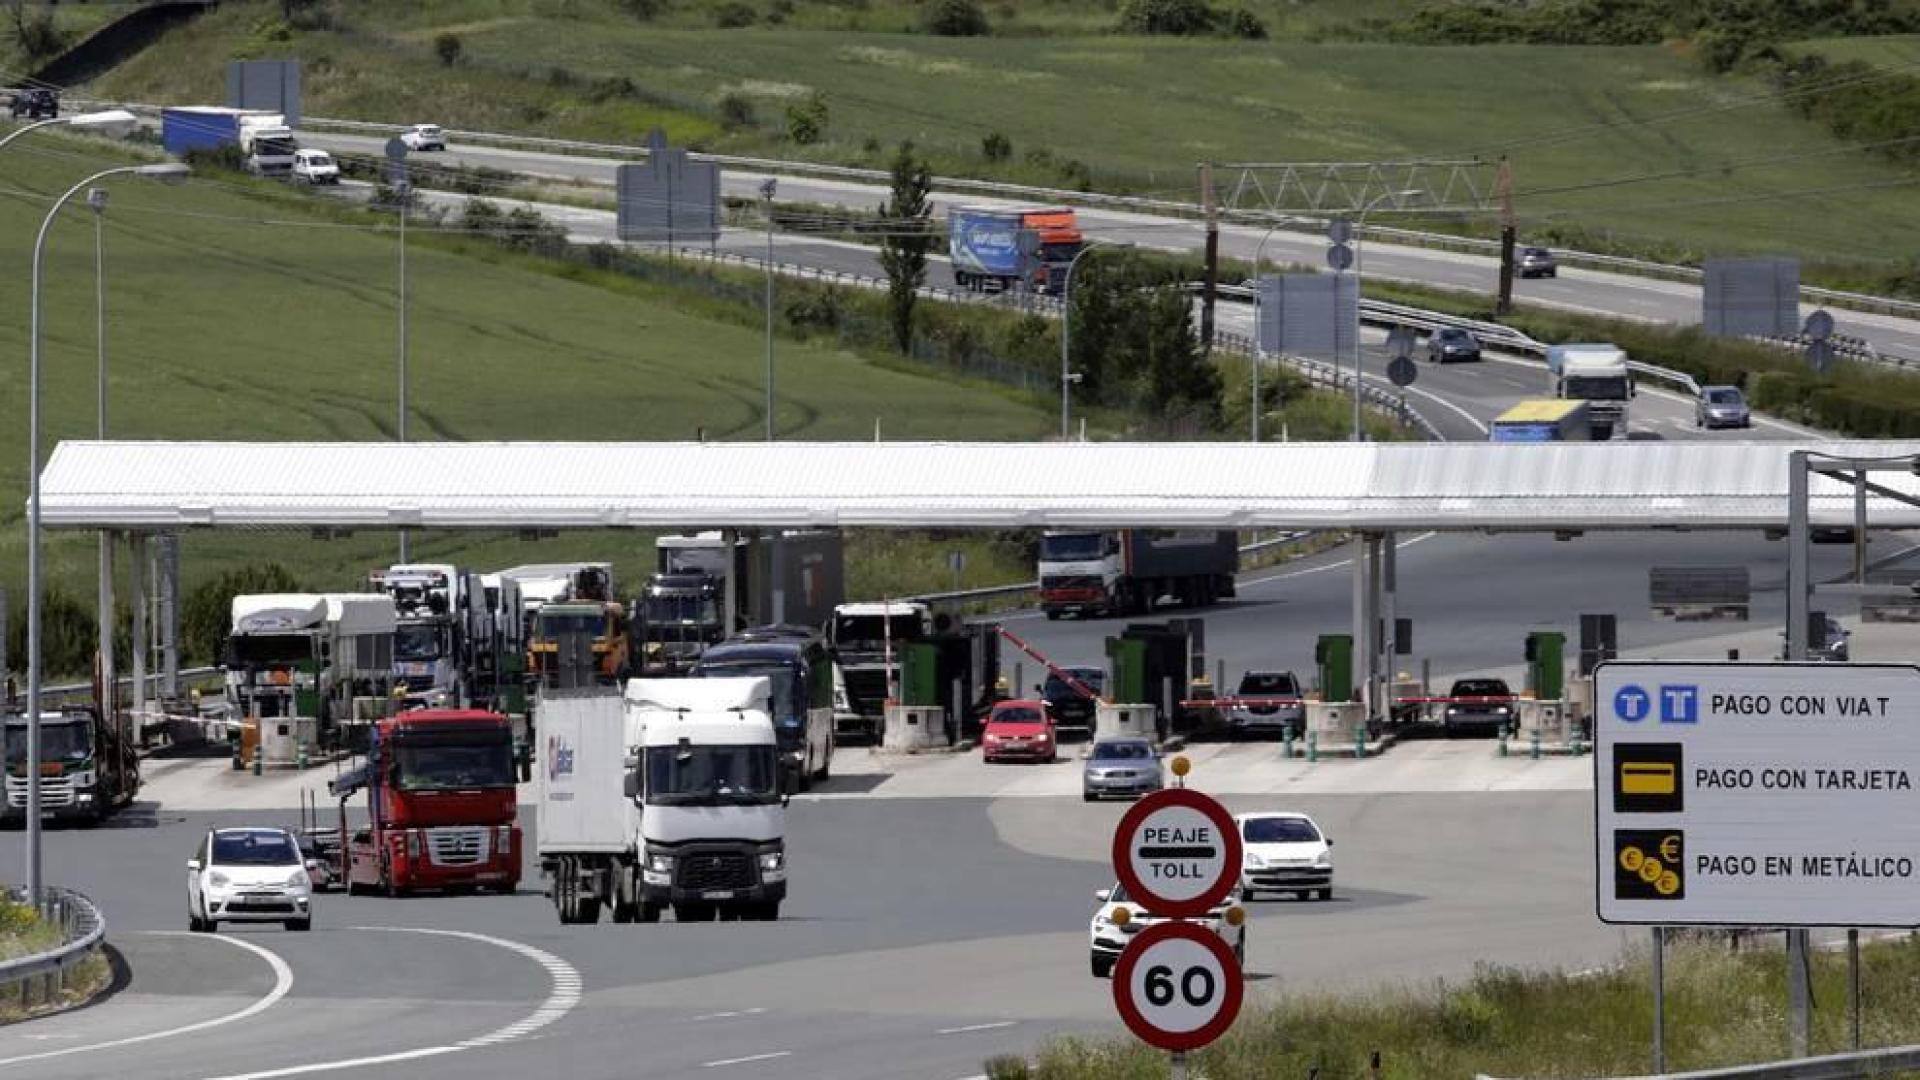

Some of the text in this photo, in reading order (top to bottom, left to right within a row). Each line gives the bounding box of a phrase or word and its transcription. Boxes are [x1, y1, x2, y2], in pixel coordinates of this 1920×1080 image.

[1712, 695, 1889, 716] PAGO CON VIA T
[1696, 769, 1911, 790] PAGO CON TARJETA
[1144, 828, 1210, 844] PEAJE
[1150, 863, 1204, 879] TOLL
[1697, 851, 1913, 877] PAGO EN METÁLICO
[1144, 965, 1215, 1007] 60
